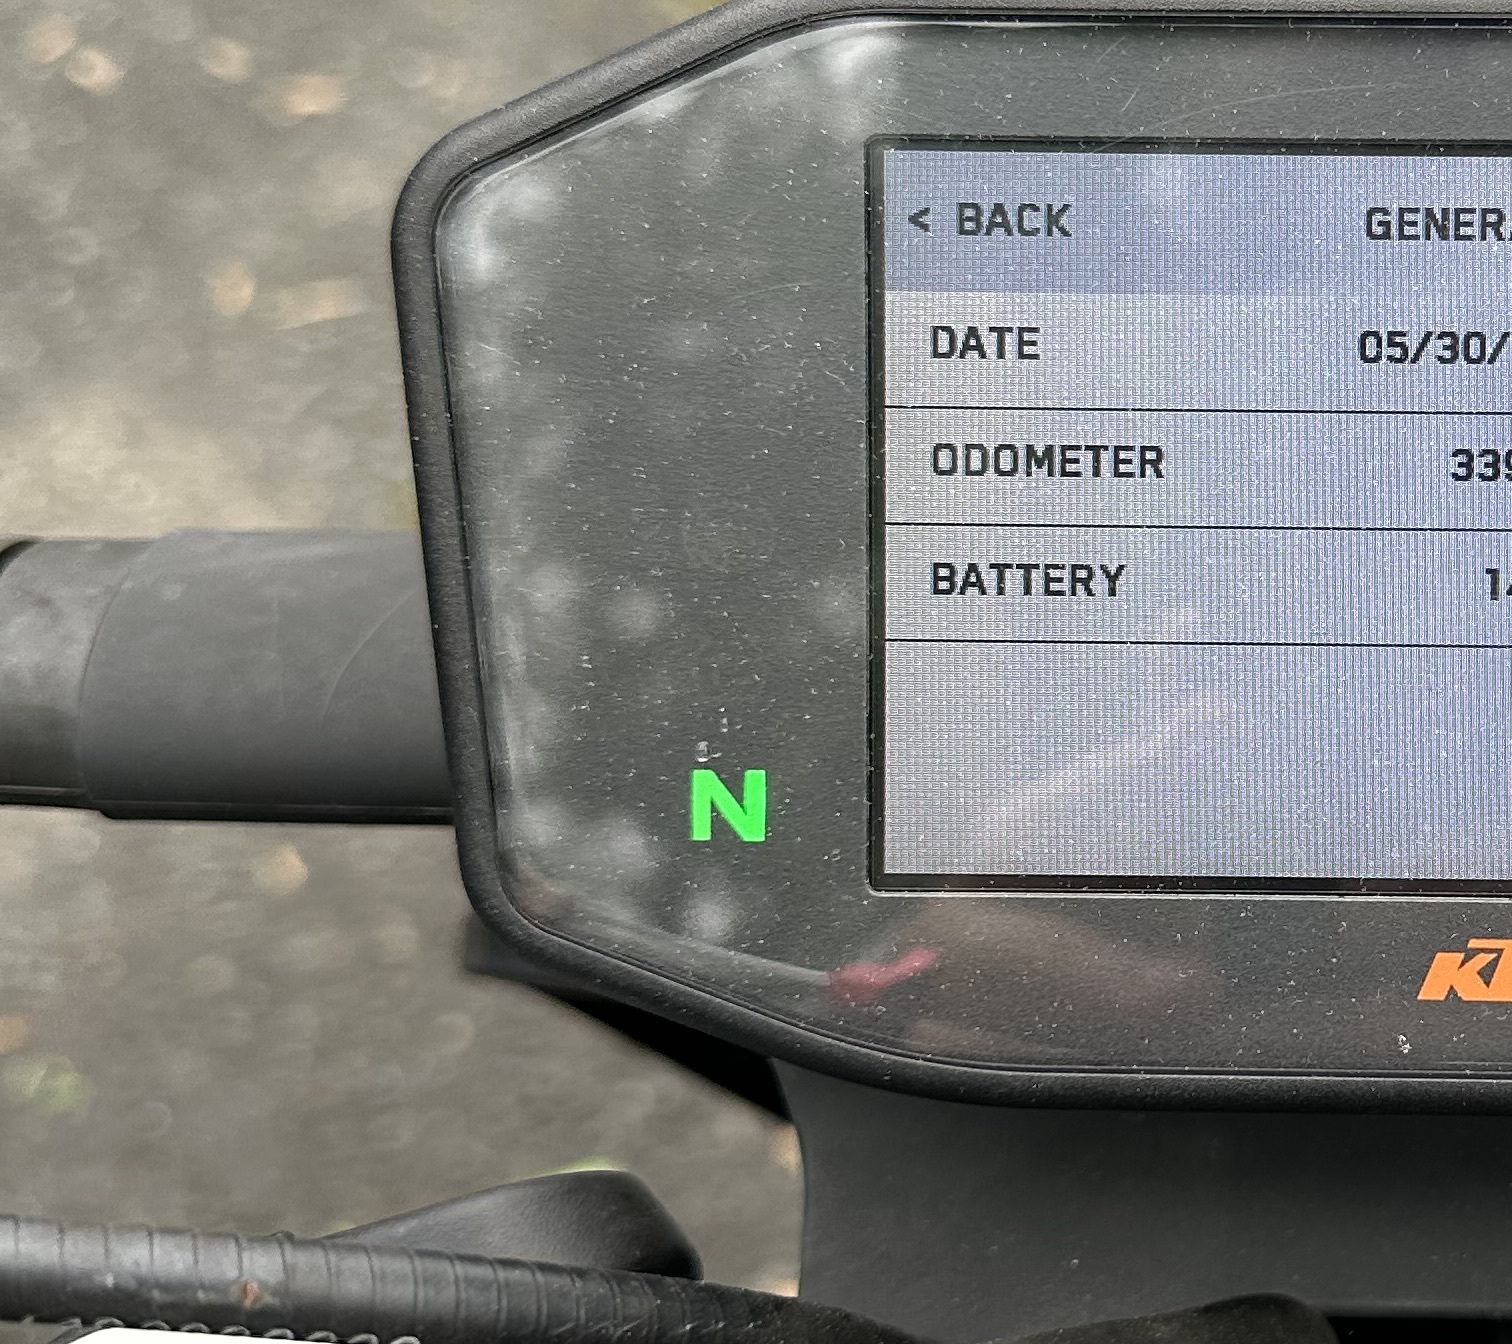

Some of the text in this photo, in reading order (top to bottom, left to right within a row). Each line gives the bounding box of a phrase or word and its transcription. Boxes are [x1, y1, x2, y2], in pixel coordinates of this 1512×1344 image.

[956, 202, 1073, 238] BACK
[931, 325, 1041, 361] DATE
[931, 442, 1165, 479] ODOMETER
[931, 561, 1126, 598] BATTERY
[691, 768, 767, 842] N
